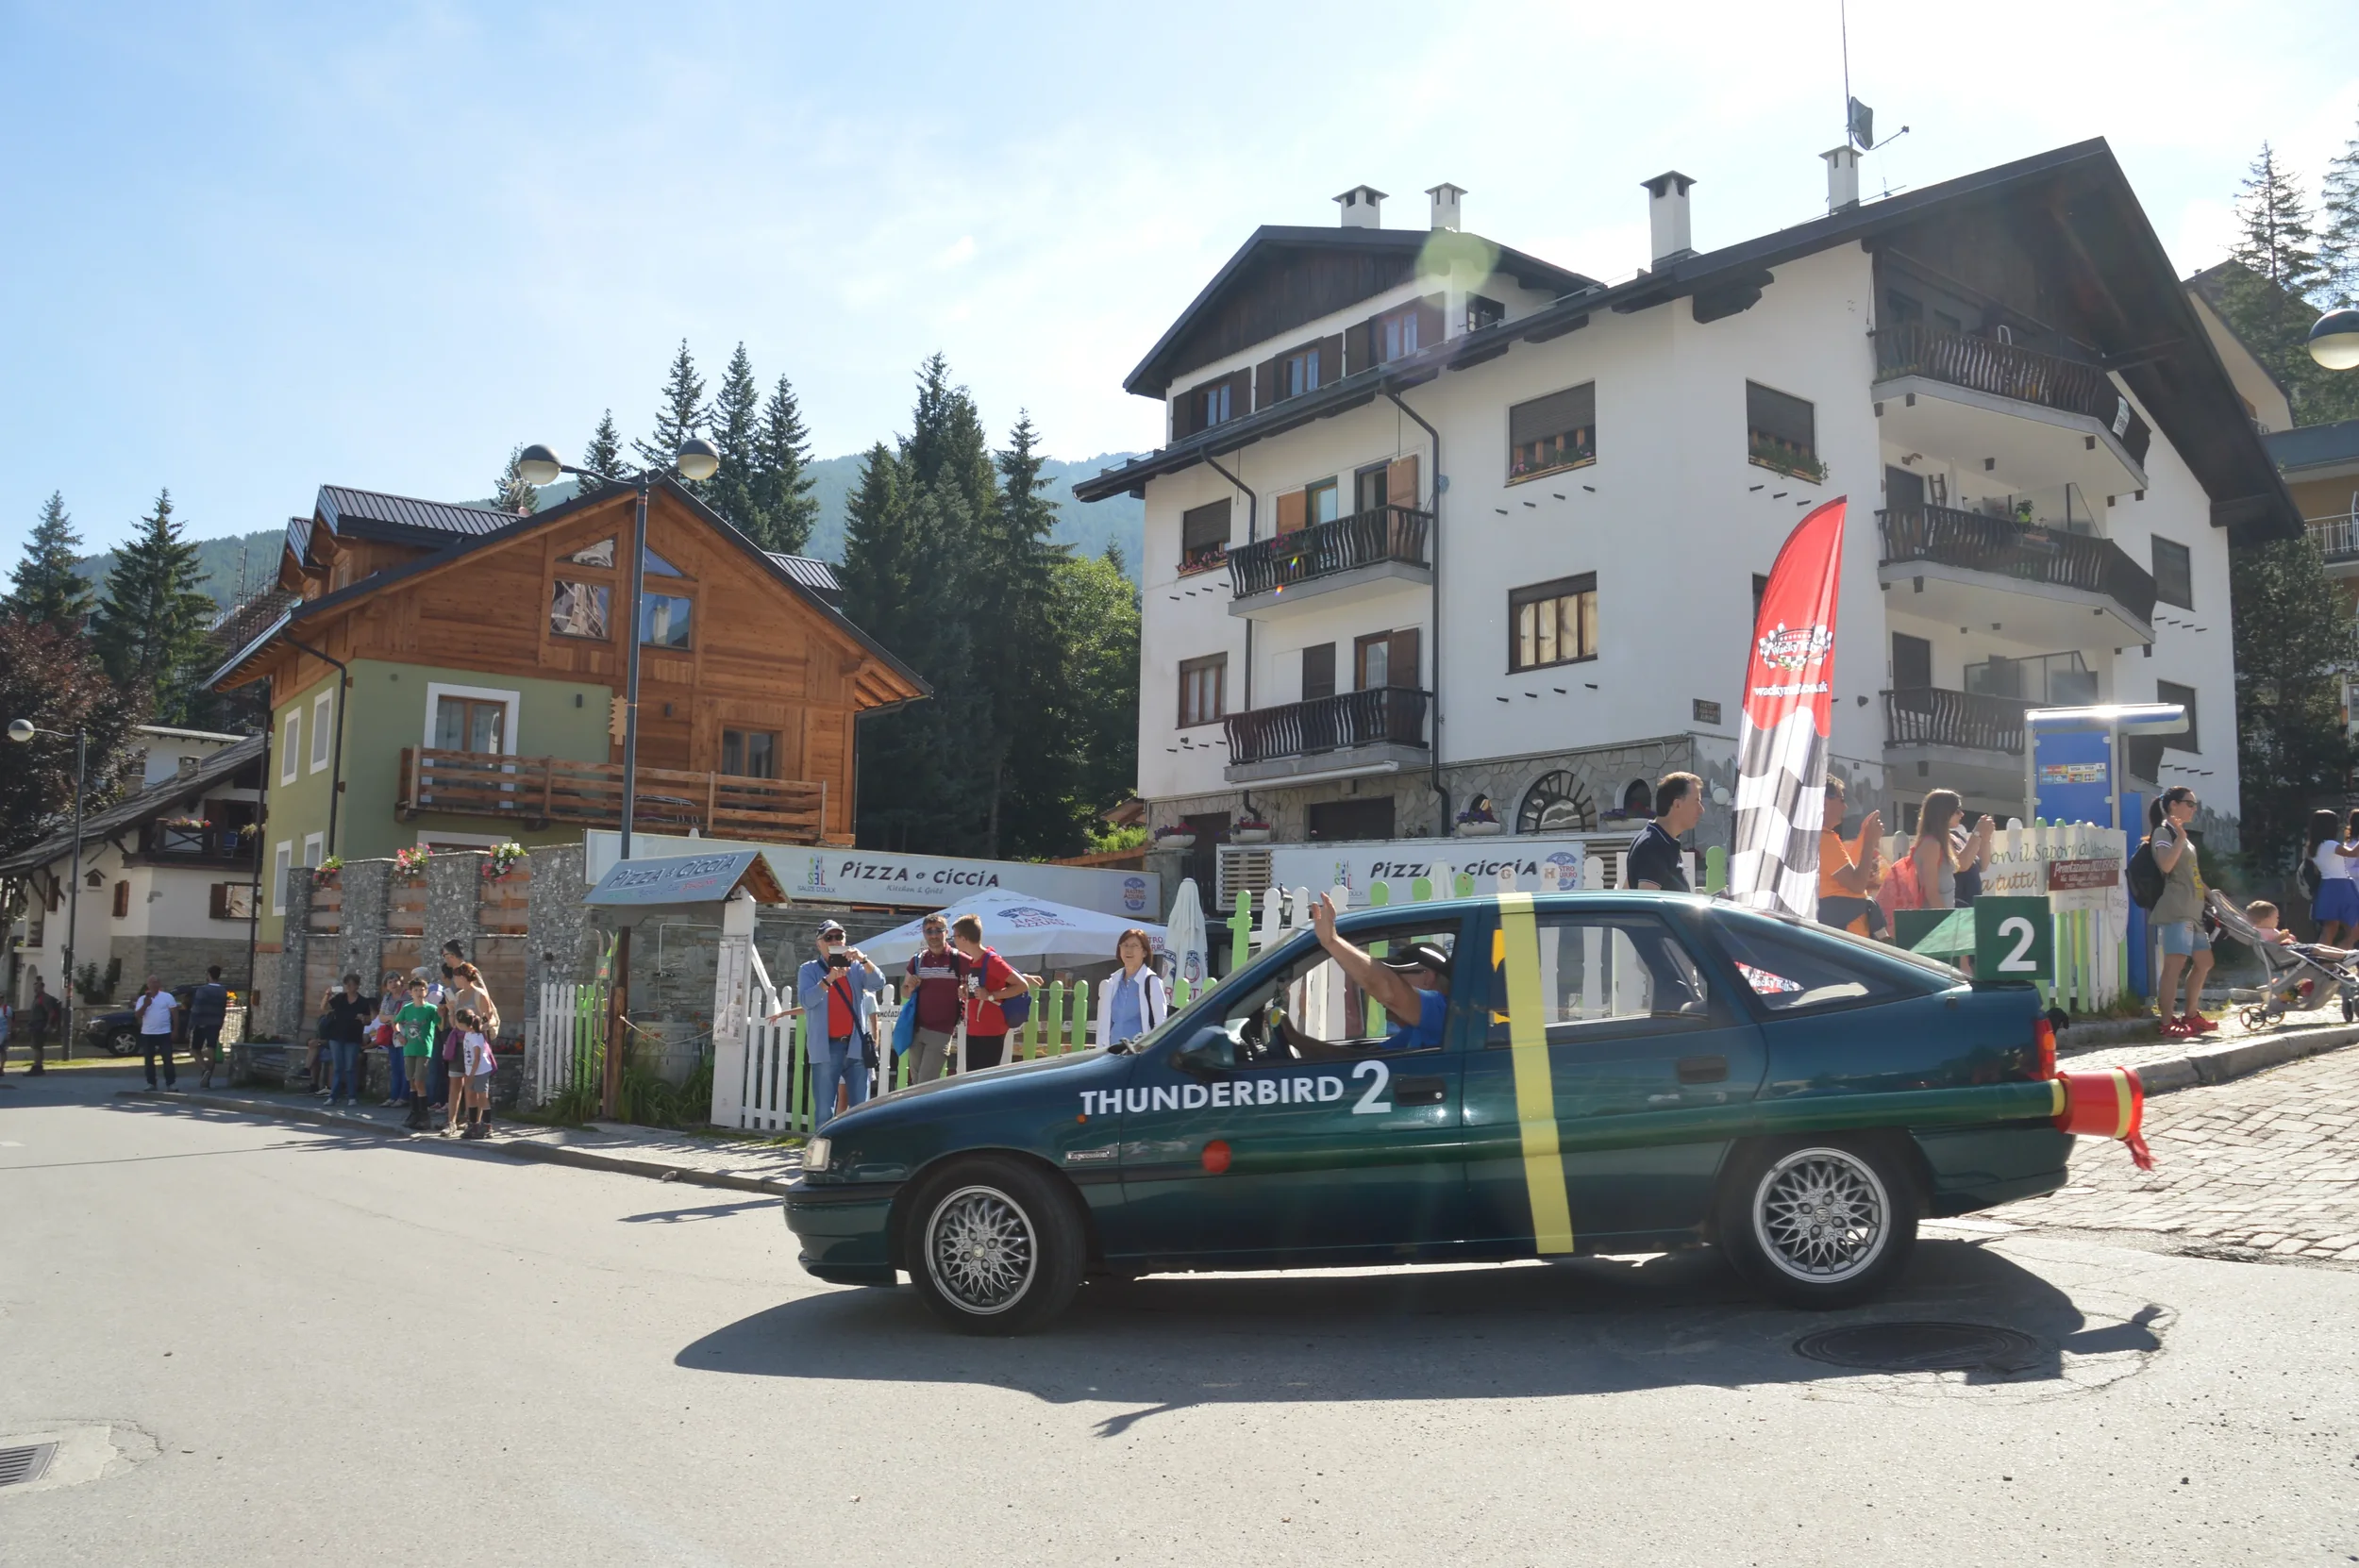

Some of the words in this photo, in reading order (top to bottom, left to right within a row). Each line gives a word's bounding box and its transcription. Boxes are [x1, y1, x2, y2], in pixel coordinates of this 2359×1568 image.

[2019, 842, 2032, 861] il
[886, 885, 915, 893] Kitchen
[1998, 916, 2037, 971] 2
[1079, 1076, 1345, 1115] THUNDERBIRD
[1351, 1059, 1392, 1114] 2
[1067, 1151, 1108, 1161] Expression
